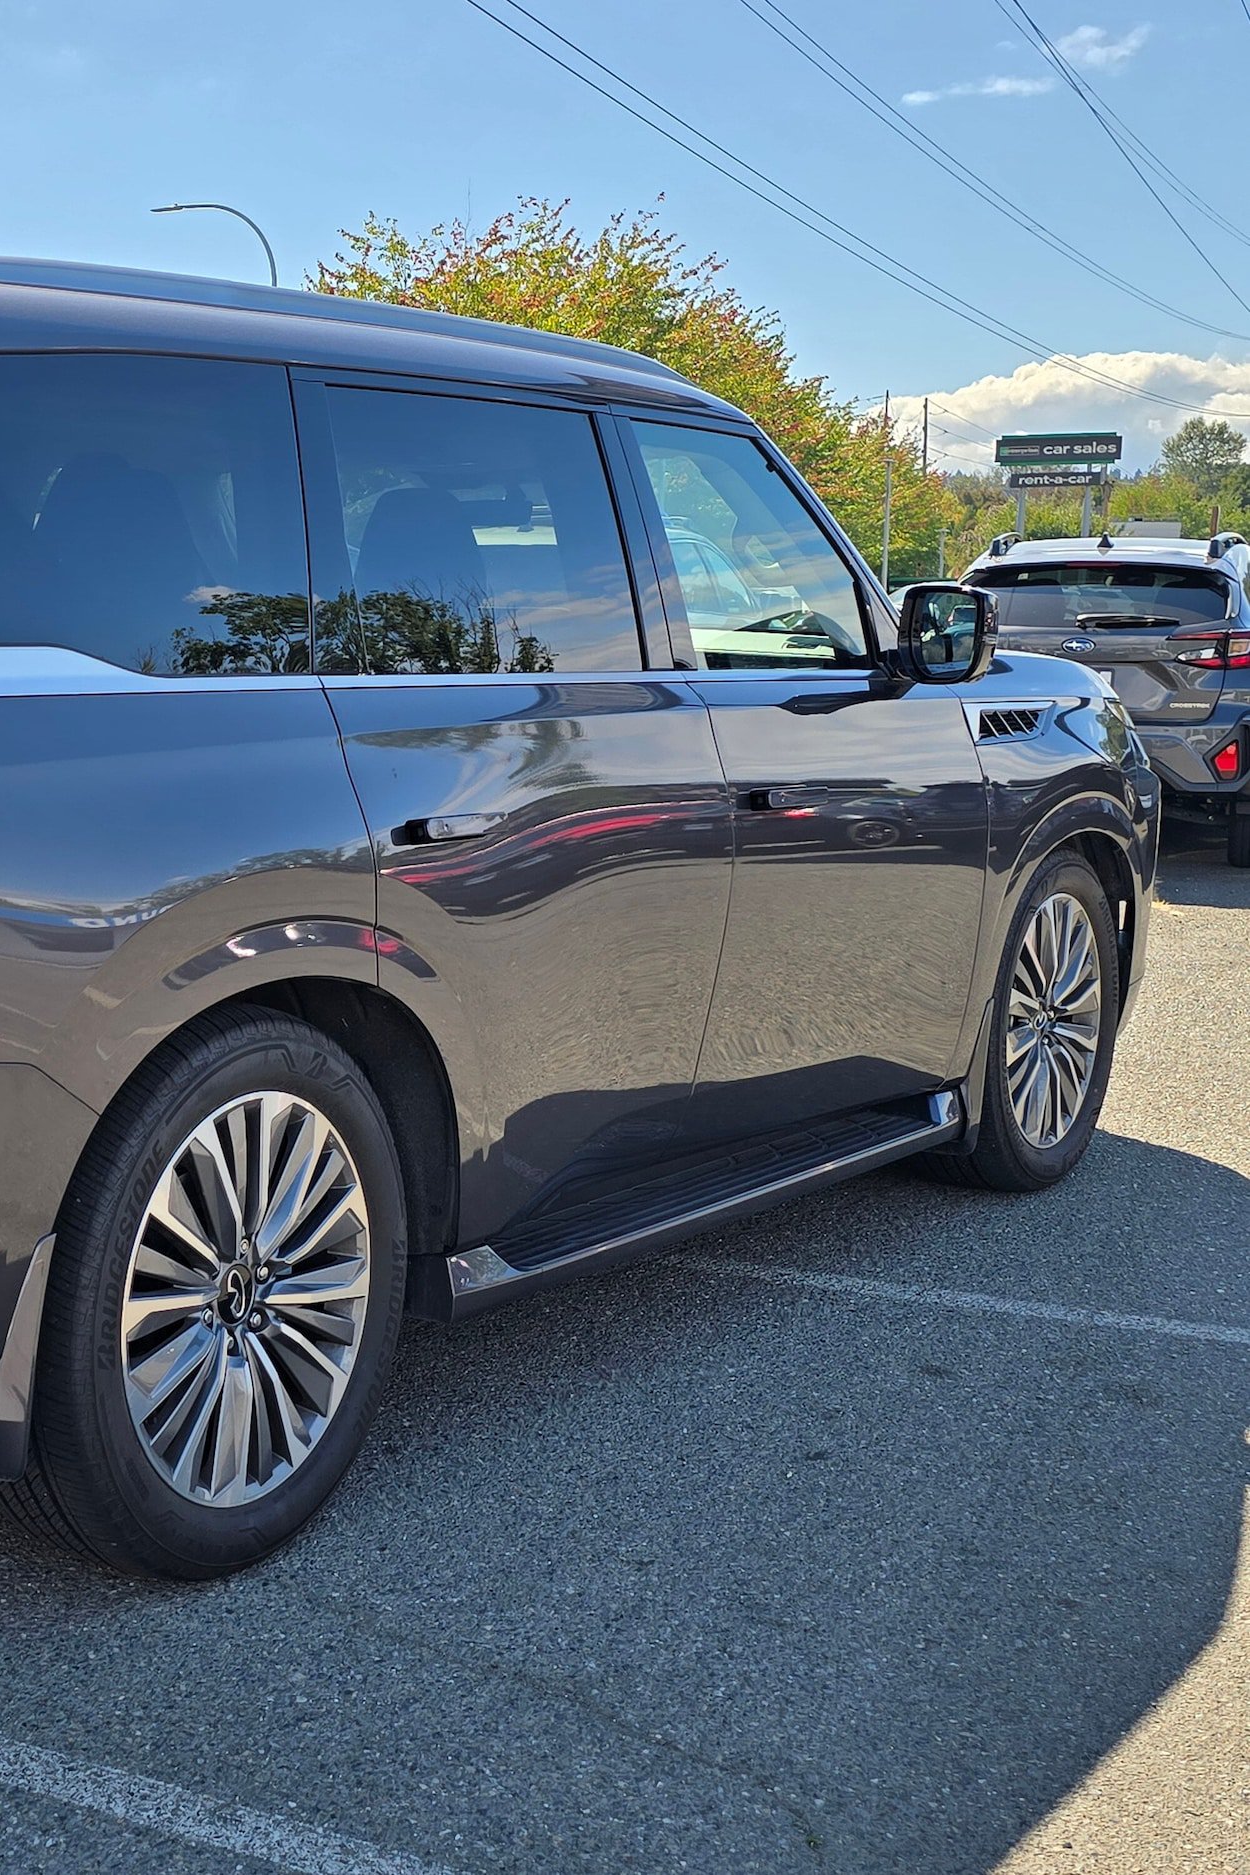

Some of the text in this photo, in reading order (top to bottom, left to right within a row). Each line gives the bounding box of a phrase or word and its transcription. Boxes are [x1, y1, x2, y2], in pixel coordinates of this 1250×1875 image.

[1043, 445, 1071, 455] car
[1072, 441, 1117, 454] sales
[1018, 474, 1093, 485] rent-a-car
[96, 1138, 166, 1370] BRIDGESTONE
